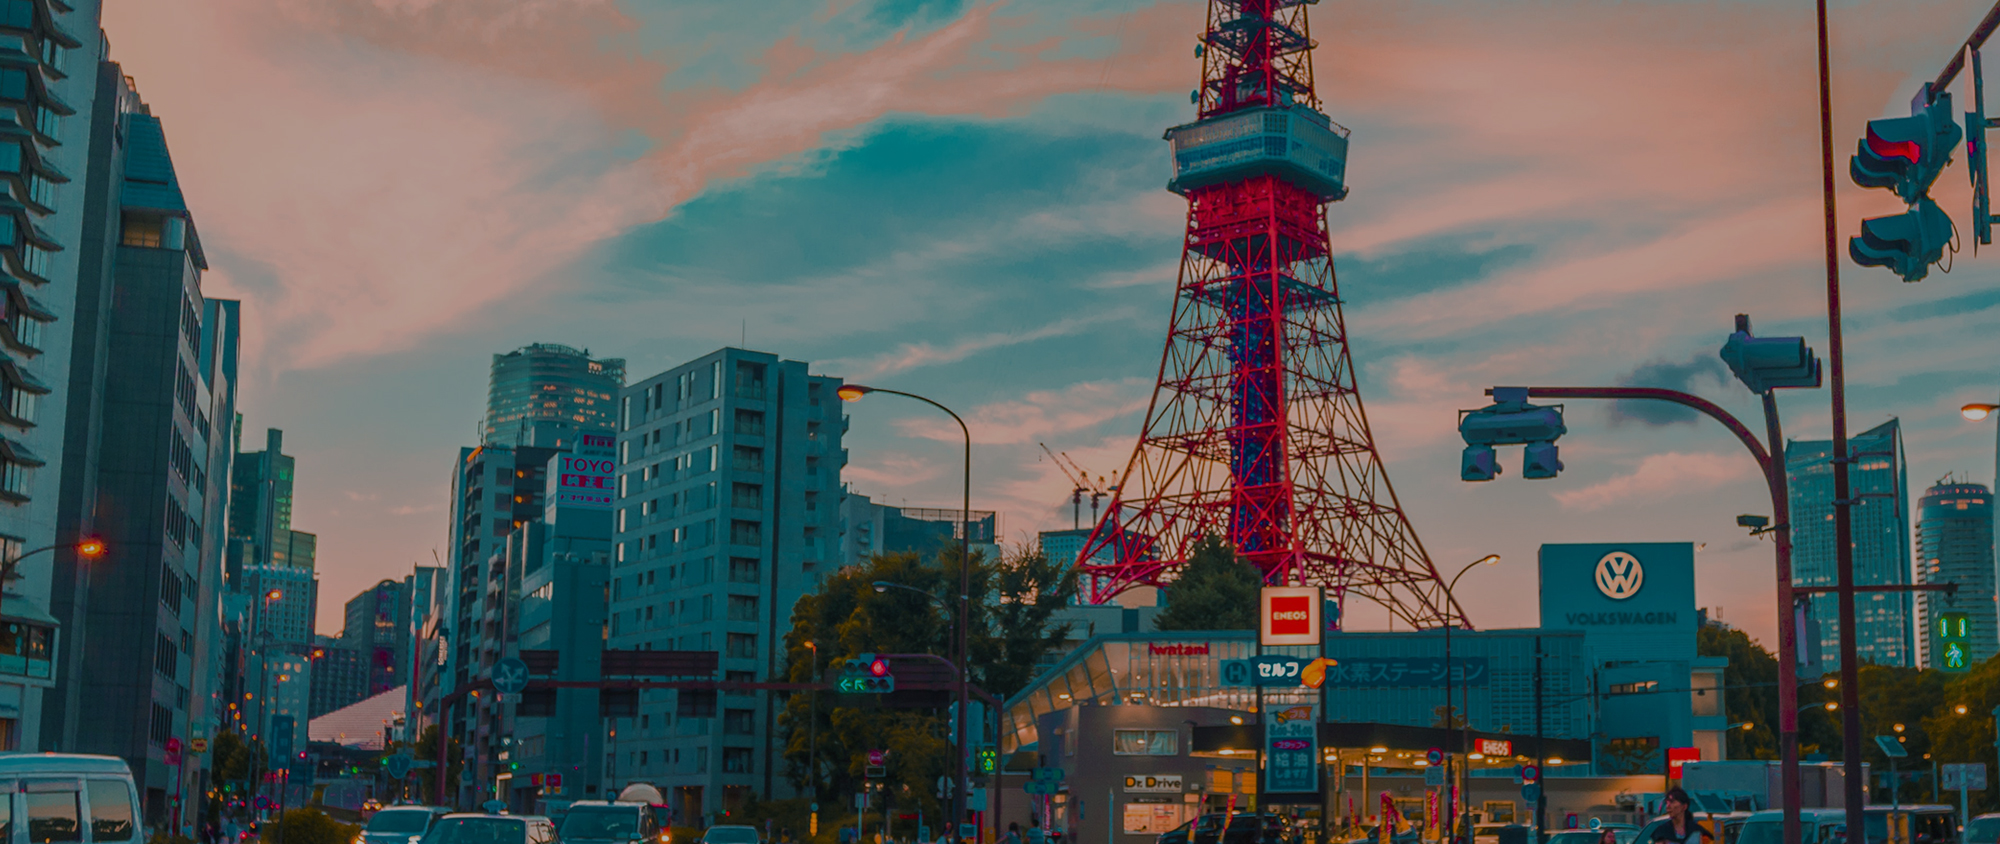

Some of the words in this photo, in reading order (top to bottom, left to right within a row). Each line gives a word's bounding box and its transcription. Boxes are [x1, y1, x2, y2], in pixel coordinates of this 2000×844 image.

[1272, 610, 1307, 621] ENEOS
[1566, 612, 1677, 625] VOLKSWAGEN
[1148, 642, 1209, 655] Iwatani
[1257, 661, 1299, 677] セルフ
[1331, 662, 1483, 682] 水素ステーション
[1482, 740, 1509, 756] ENEOS
[1275, 753, 1308, 767] 給油
[1125, 777, 1143, 788] Dr.
[1145, 777, 1182, 788] Drive
